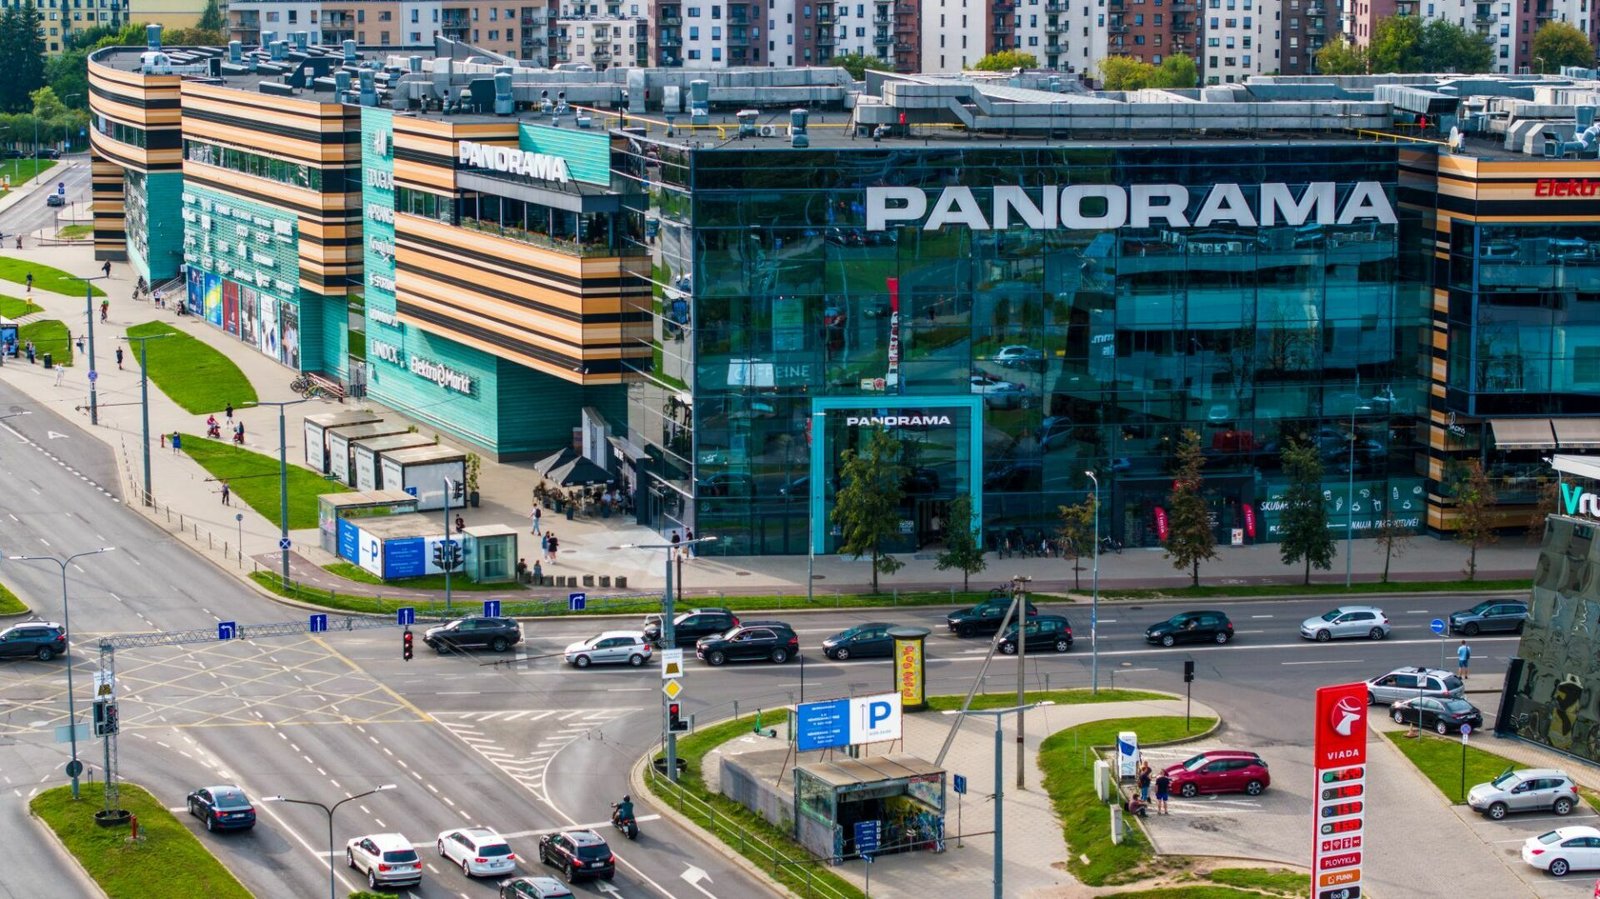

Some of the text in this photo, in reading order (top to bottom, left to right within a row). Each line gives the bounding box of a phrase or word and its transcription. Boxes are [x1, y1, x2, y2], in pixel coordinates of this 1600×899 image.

[458, 140, 568, 183] PANORAMA
[866, 181, 1398, 231] PANORAMA
[846, 415, 951, 427] PANORAMA
[869, 701, 891, 729] P
[1327, 749, 1359, 760] VIADA
[1325, 855, 1356, 868] PLOVYKLA
